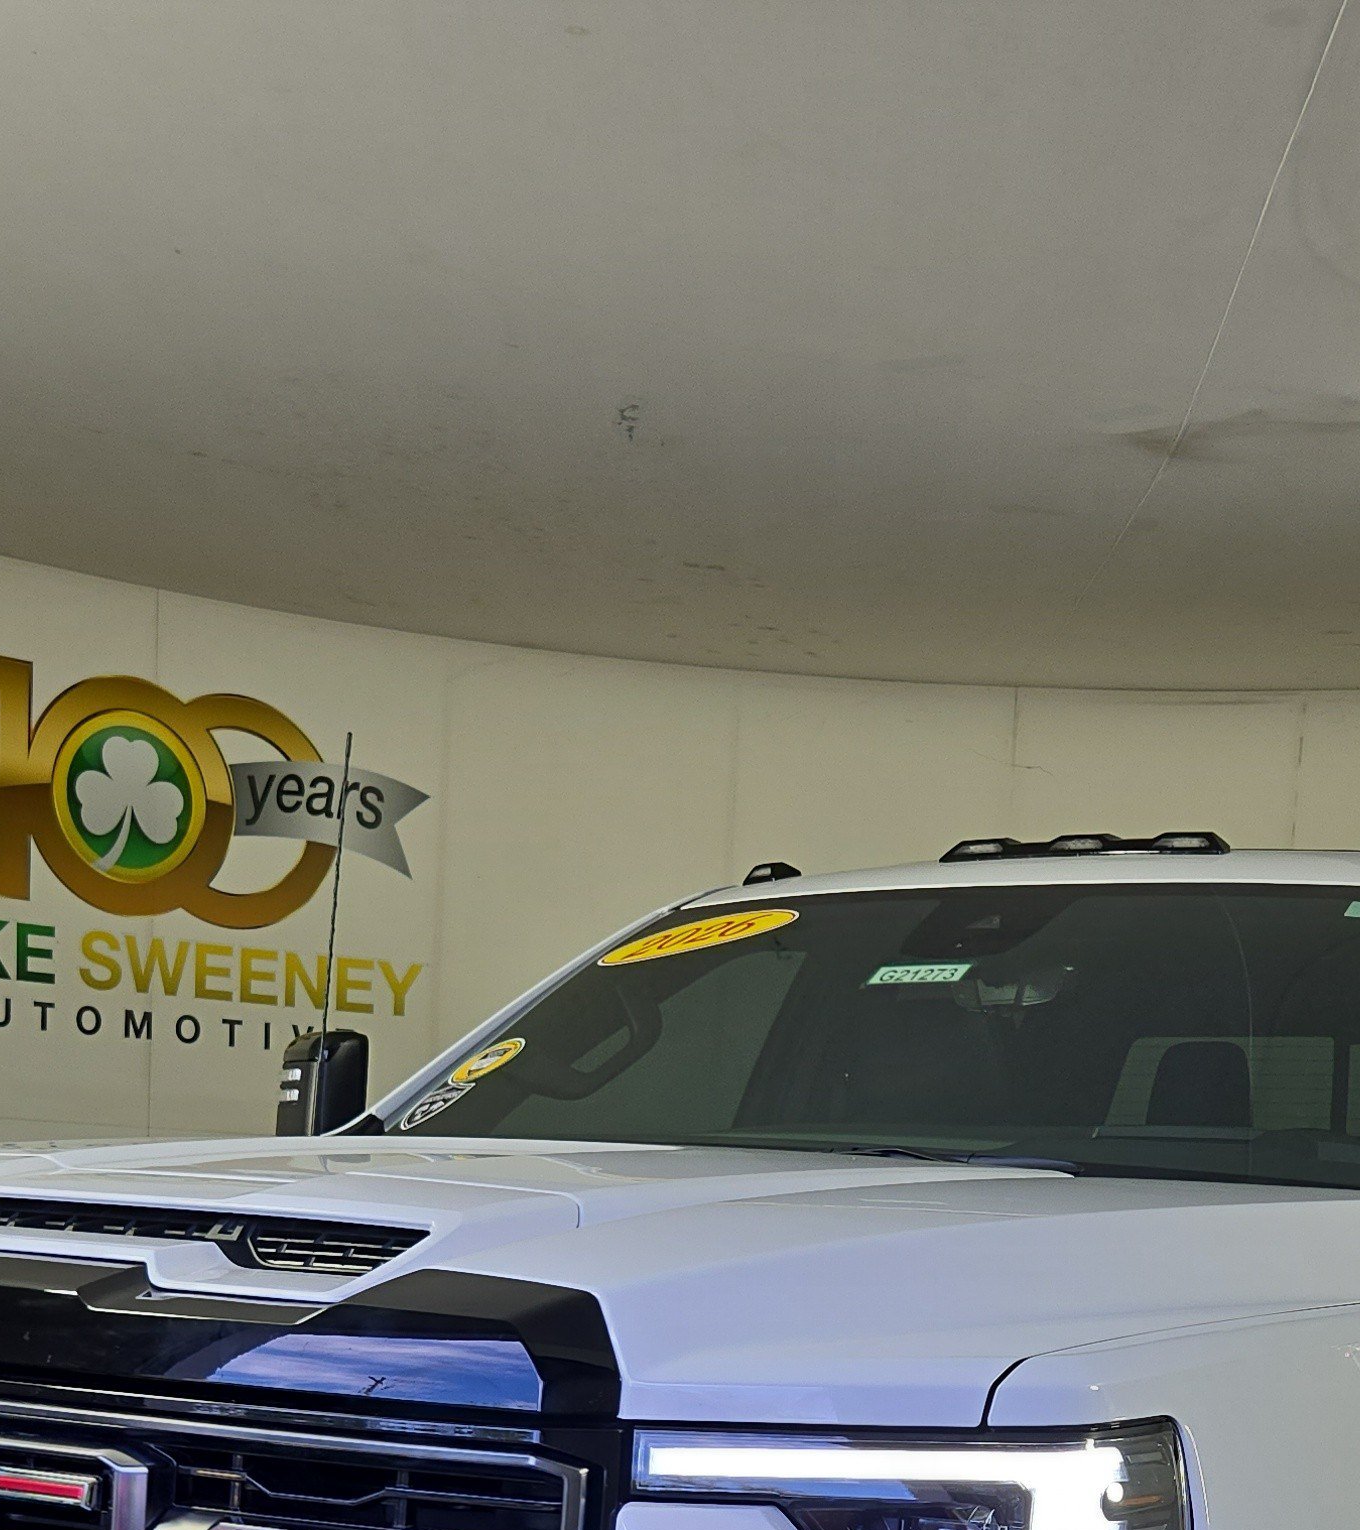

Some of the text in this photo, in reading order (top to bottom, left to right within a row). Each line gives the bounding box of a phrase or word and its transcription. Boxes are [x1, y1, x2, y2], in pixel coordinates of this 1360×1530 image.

[244, 767, 385, 829] years
[621, 913, 774, 960] 2026
[79, 929, 423, 1016] SWEENEY
[879, 968, 959, 982] G21273
